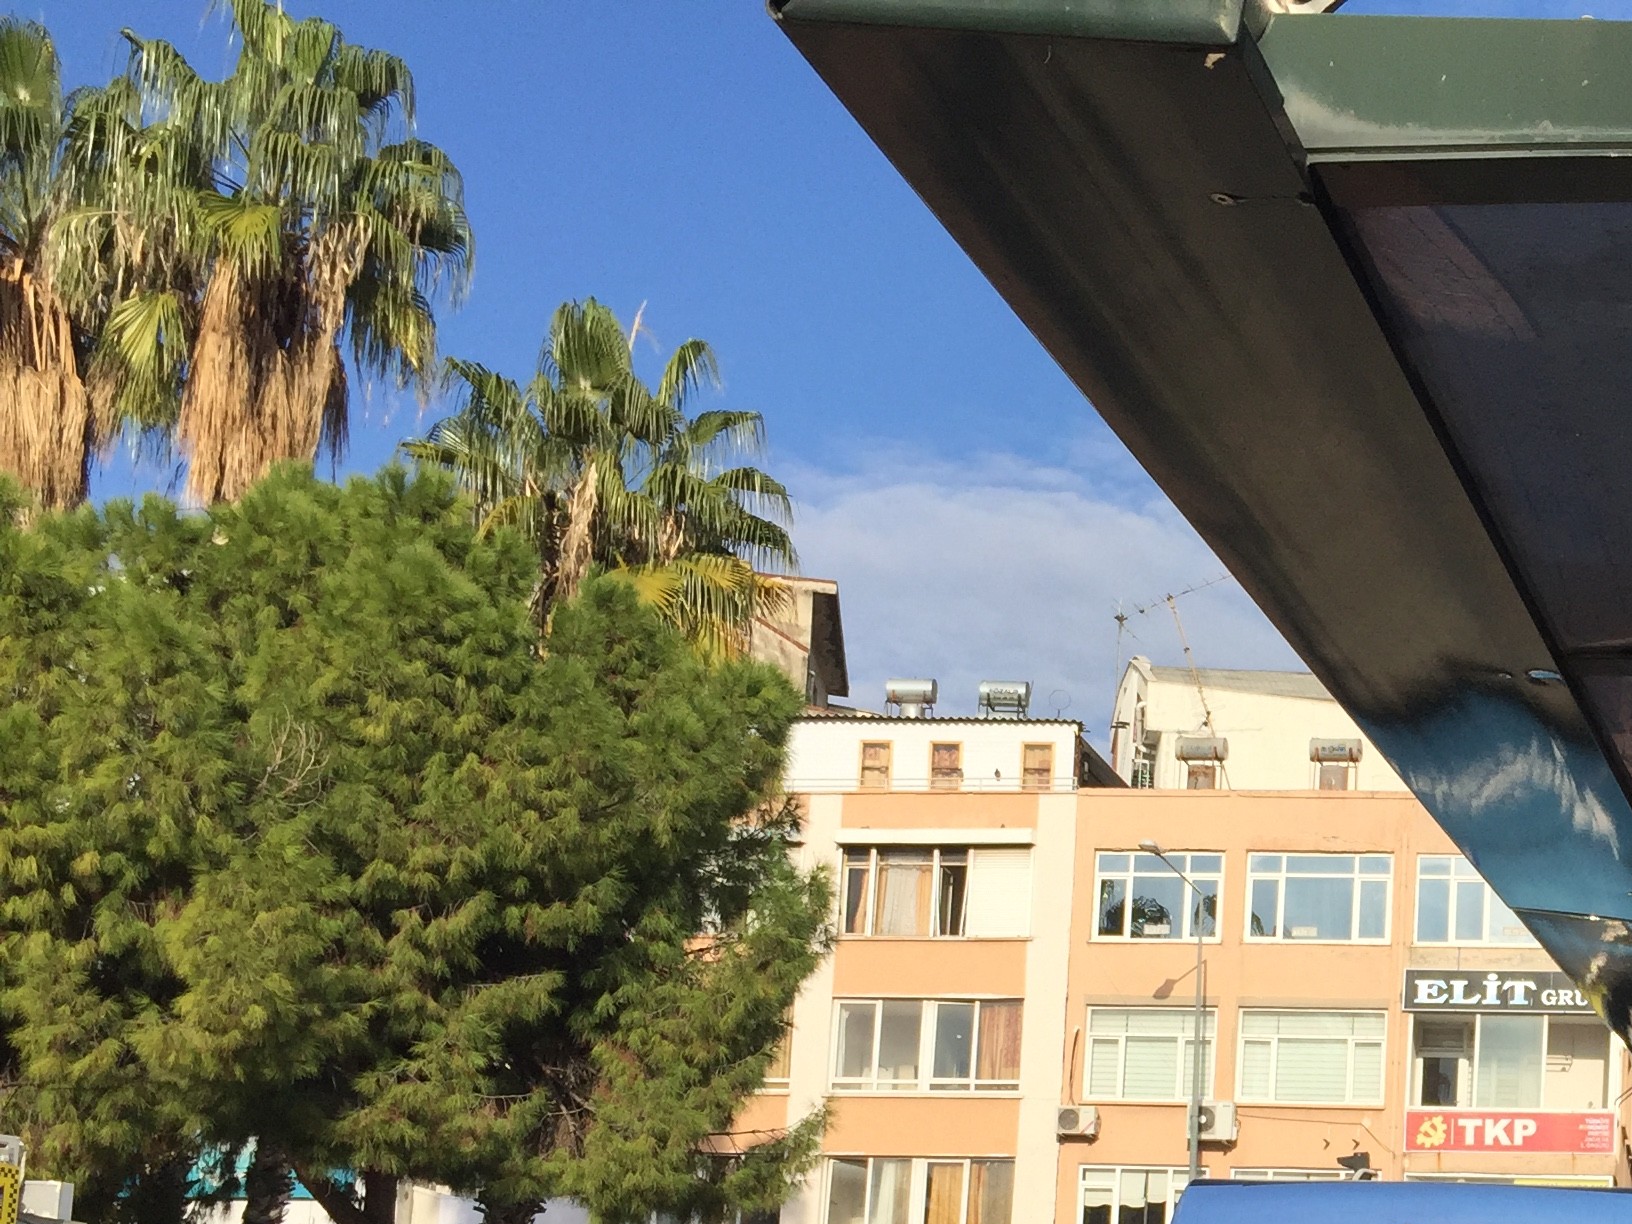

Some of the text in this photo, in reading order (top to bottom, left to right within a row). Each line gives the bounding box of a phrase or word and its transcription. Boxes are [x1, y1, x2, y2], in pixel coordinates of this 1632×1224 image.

[1414, 973, 1588, 1006] ELİT GRU
[1457, 1118, 1537, 1146] TKP
